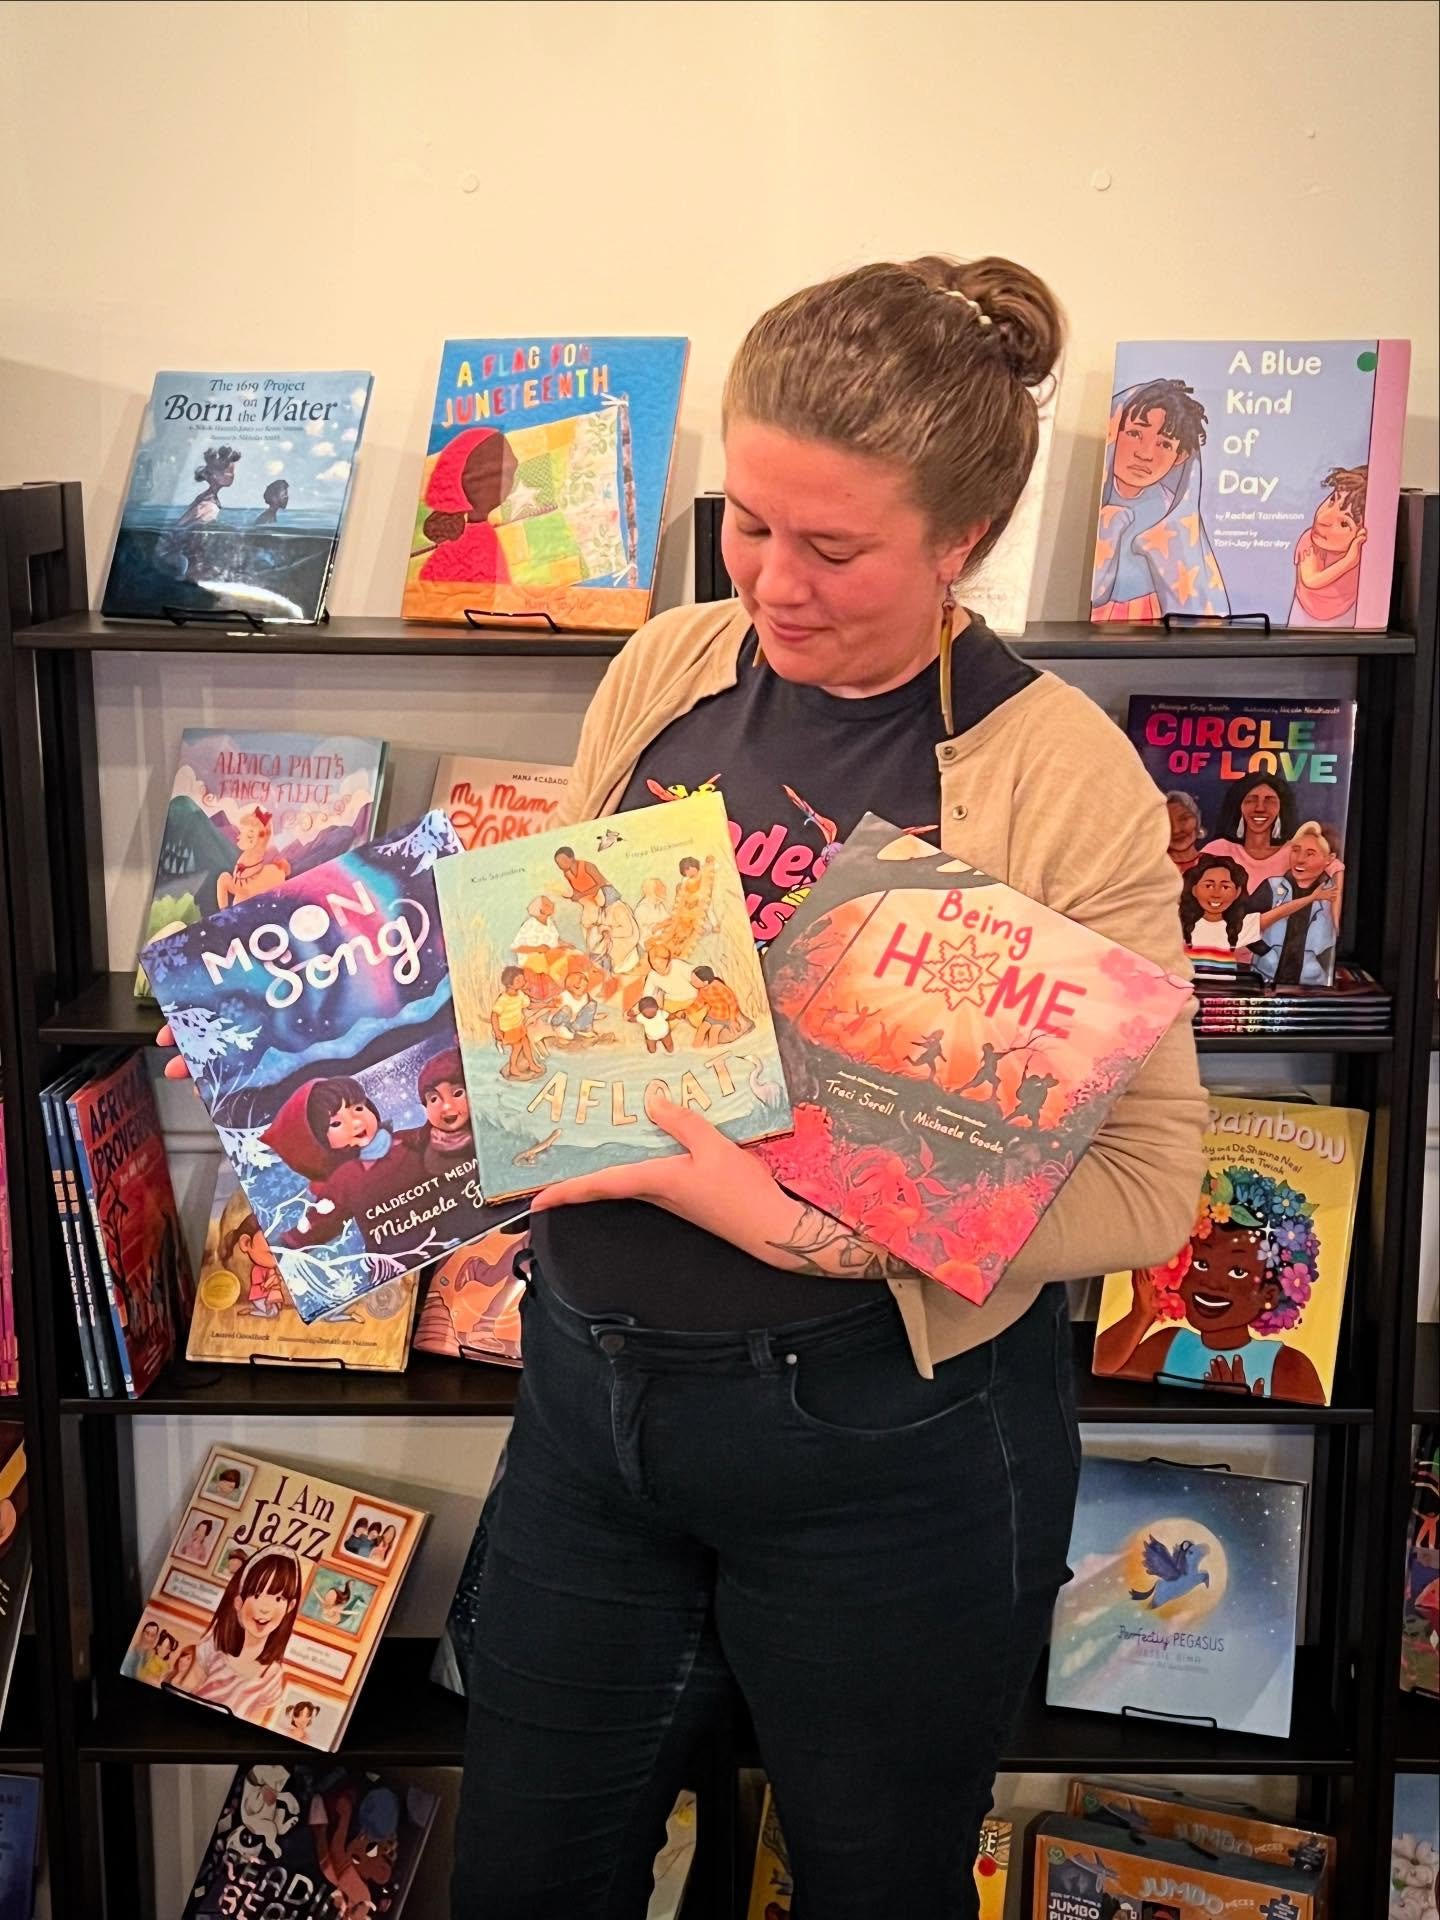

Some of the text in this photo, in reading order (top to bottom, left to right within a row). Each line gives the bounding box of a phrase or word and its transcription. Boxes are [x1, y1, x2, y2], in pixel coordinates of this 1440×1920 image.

[457, 343, 592, 388] A FLAG FOR
[1228, 349, 1321, 375] A Blue
[209, 379, 305, 393] The 1619 Project
[243, 399, 258, 408] on
[442, 365, 608, 428] JUNETEENTH
[1227, 388, 1292, 415] Kind
[164, 394, 233, 422] Born
[238, 409, 257, 422] the
[261, 395, 338, 422] Water
[1223, 428, 1260, 457] of
[1218, 470, 1279, 502] Day
[1145, 713, 1316, 750] CIRCLE
[214, 752, 281, 776] ALPACA
[1168, 750, 1338, 783] OF LOVE
[219, 779, 272, 801] FANCY
[450, 783, 482, 819] My
[201, 880, 376, 985] MOON
[938, 889, 1033, 960] Being
[265, 898, 430, 1008] Song
[527, 1051, 735, 1126] AFLOAT
[826, 1080, 857, 1100] Traci
[859, 1092, 895, 1116] Sorell
[913, 1112, 964, 1139] Michaela
[969, 1131, 1004, 1154] Goode
[365, 1176, 440, 1220] CALDECOTT
[369, 1197, 458, 1245] Michaela
[271, 1475, 335, 1523] I Am
[233, 1499, 331, 1561] Jazz
[1173, 1632, 1225, 1652] PEGASUS
[1048, 1898, 1101, 1920] JUMBO
[1140, 1876, 1225, 1915] JUMBO
